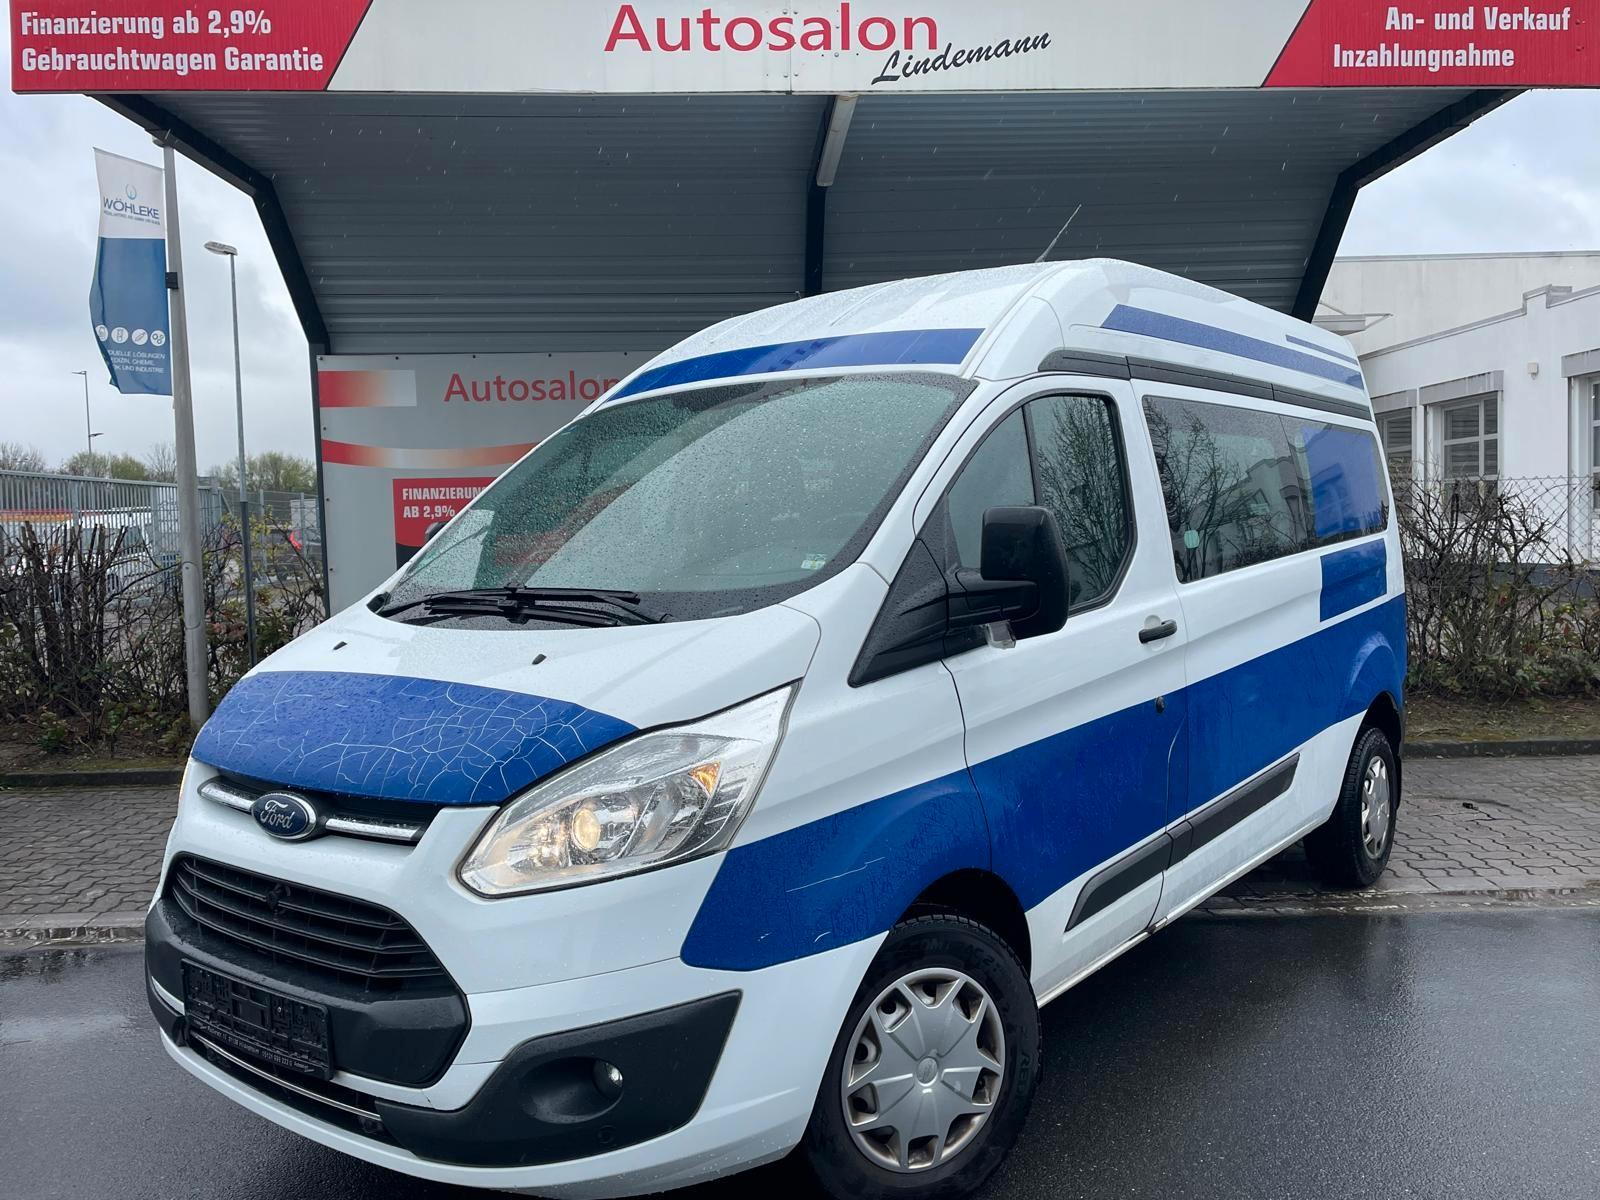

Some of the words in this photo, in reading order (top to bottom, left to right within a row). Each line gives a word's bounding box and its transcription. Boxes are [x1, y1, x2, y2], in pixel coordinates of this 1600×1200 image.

[21, 11, 164, 39] Finanzierung
[173, 10, 199, 34] ab
[208, 10, 271, 38] 2,9%
[604, 2, 938, 52] Autosalon
[1385, 7, 1424, 30] An-
[1434, 7, 1474, 30] und
[1484, 7, 1570, 30] Verkauf
[22, 47, 216, 76] Gebrauchtwagen
[224, 47, 323, 71] Garantie
[871, 32, 1052, 85] Lindemann
[1334, 43, 1515, 72] Inzahlungnahme
[103, 196, 160, 220] WÖHLEKE
[402, 487, 485, 500] FINANZIERUN
[403, 506, 419, 518] AB
[423, 505, 455, 519] 2,9%
[260, 800, 296, 829] Ford
